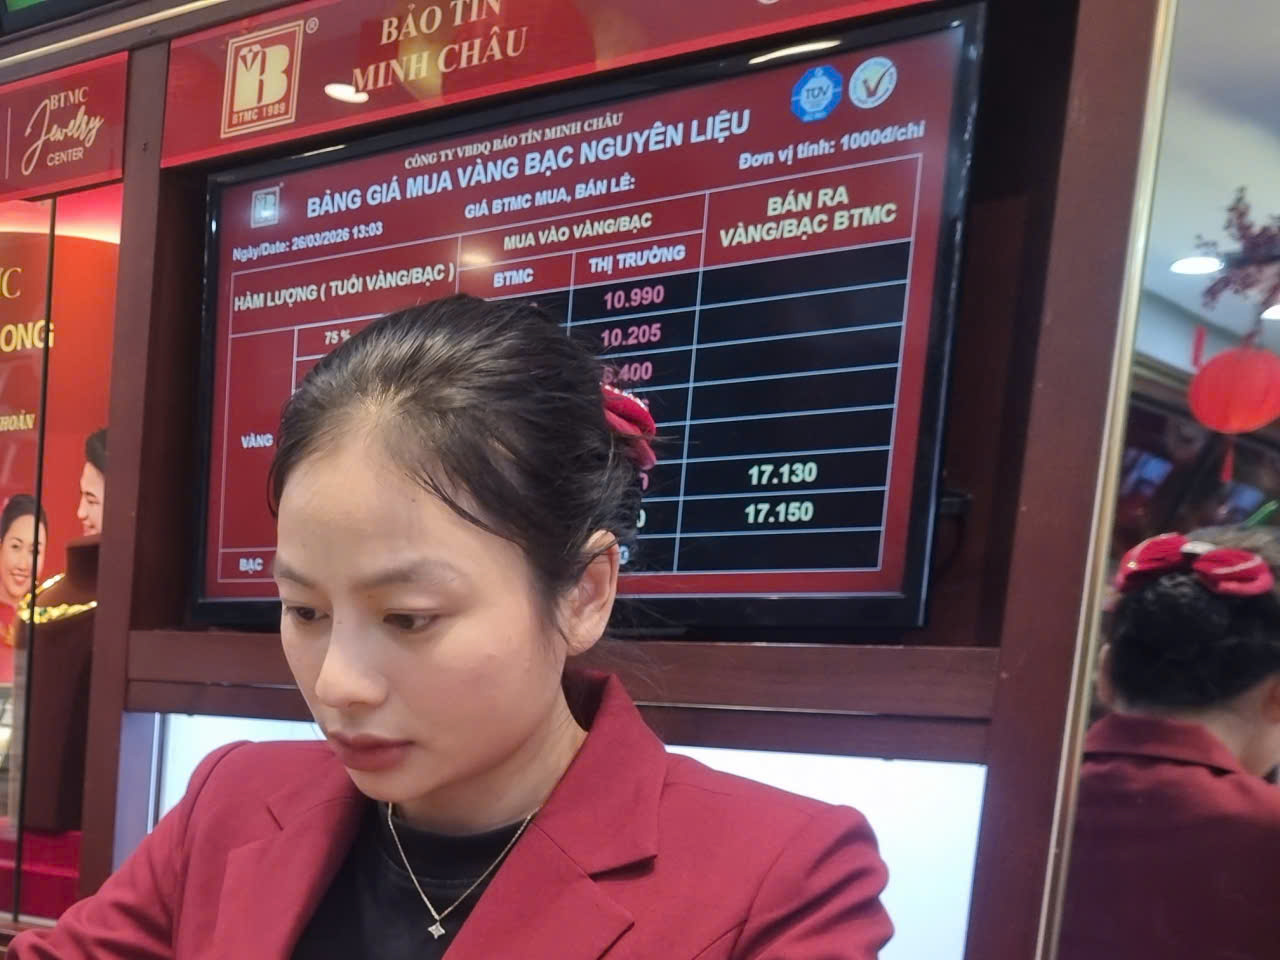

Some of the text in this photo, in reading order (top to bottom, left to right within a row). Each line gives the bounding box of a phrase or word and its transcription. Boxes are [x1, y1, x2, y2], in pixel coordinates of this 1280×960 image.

[351, 24, 529, 94] MINH CHÂU
[48, 86, 89, 111] BTMC
[21, 98, 105, 176] Jewelry
[404, 152, 438, 170] CÔNG
[438, 149, 456, 164] TY
[491, 131, 519, 154] BẢO
[519, 126, 543, 148] TÍN
[544, 120, 582, 142] MINH
[582, 112, 624, 135] CHÂU
[46, 146, 85, 167] CENTER
[366, 176, 402, 206] GIÁ
[405, 171, 454, 199] MUA
[456, 157, 520, 192] VÀNG
[523, 146, 574, 181] BẠC
[579, 121, 684, 167] NGUYÊN
[689, 108, 751, 146] LIỆU
[738, 152, 775, 170] Đơn
[777, 145, 794, 166] vị
[796, 137, 837, 160] tính:
[464, 200, 490, 220] GIÁ
[491, 194, 533, 214] BTMC
[574, 177, 607, 199] BÁN
[767, 185, 850, 218] BÁN RA
[503, 212, 654, 252] MUA VÀO VÀNG/BẠC
[719, 203, 899, 248] VÀNG/BẠC BTMC
[232, 221, 384, 263] Ngày/Date: 26/03/2026 13:03
[588, 243, 687, 274] THỊ TRƯỜNG
[233, 291, 266, 313] HÀM
[265, 282, 319, 311] LƯỢNG
[365, 264, 446, 294] VÀNG/BẠC
[492, 268, 535, 289] BTMC
[603, 284, 665, 311] 10.990
[324, 330, 339, 345] 75
[600, 322, 662, 348] 10.205
[240, 432, 274, 449] VÀNG
[748, 461, 818, 485] 17.130
[744, 500, 814, 524] 17.150
[238, 557, 264, 575] BẠC
